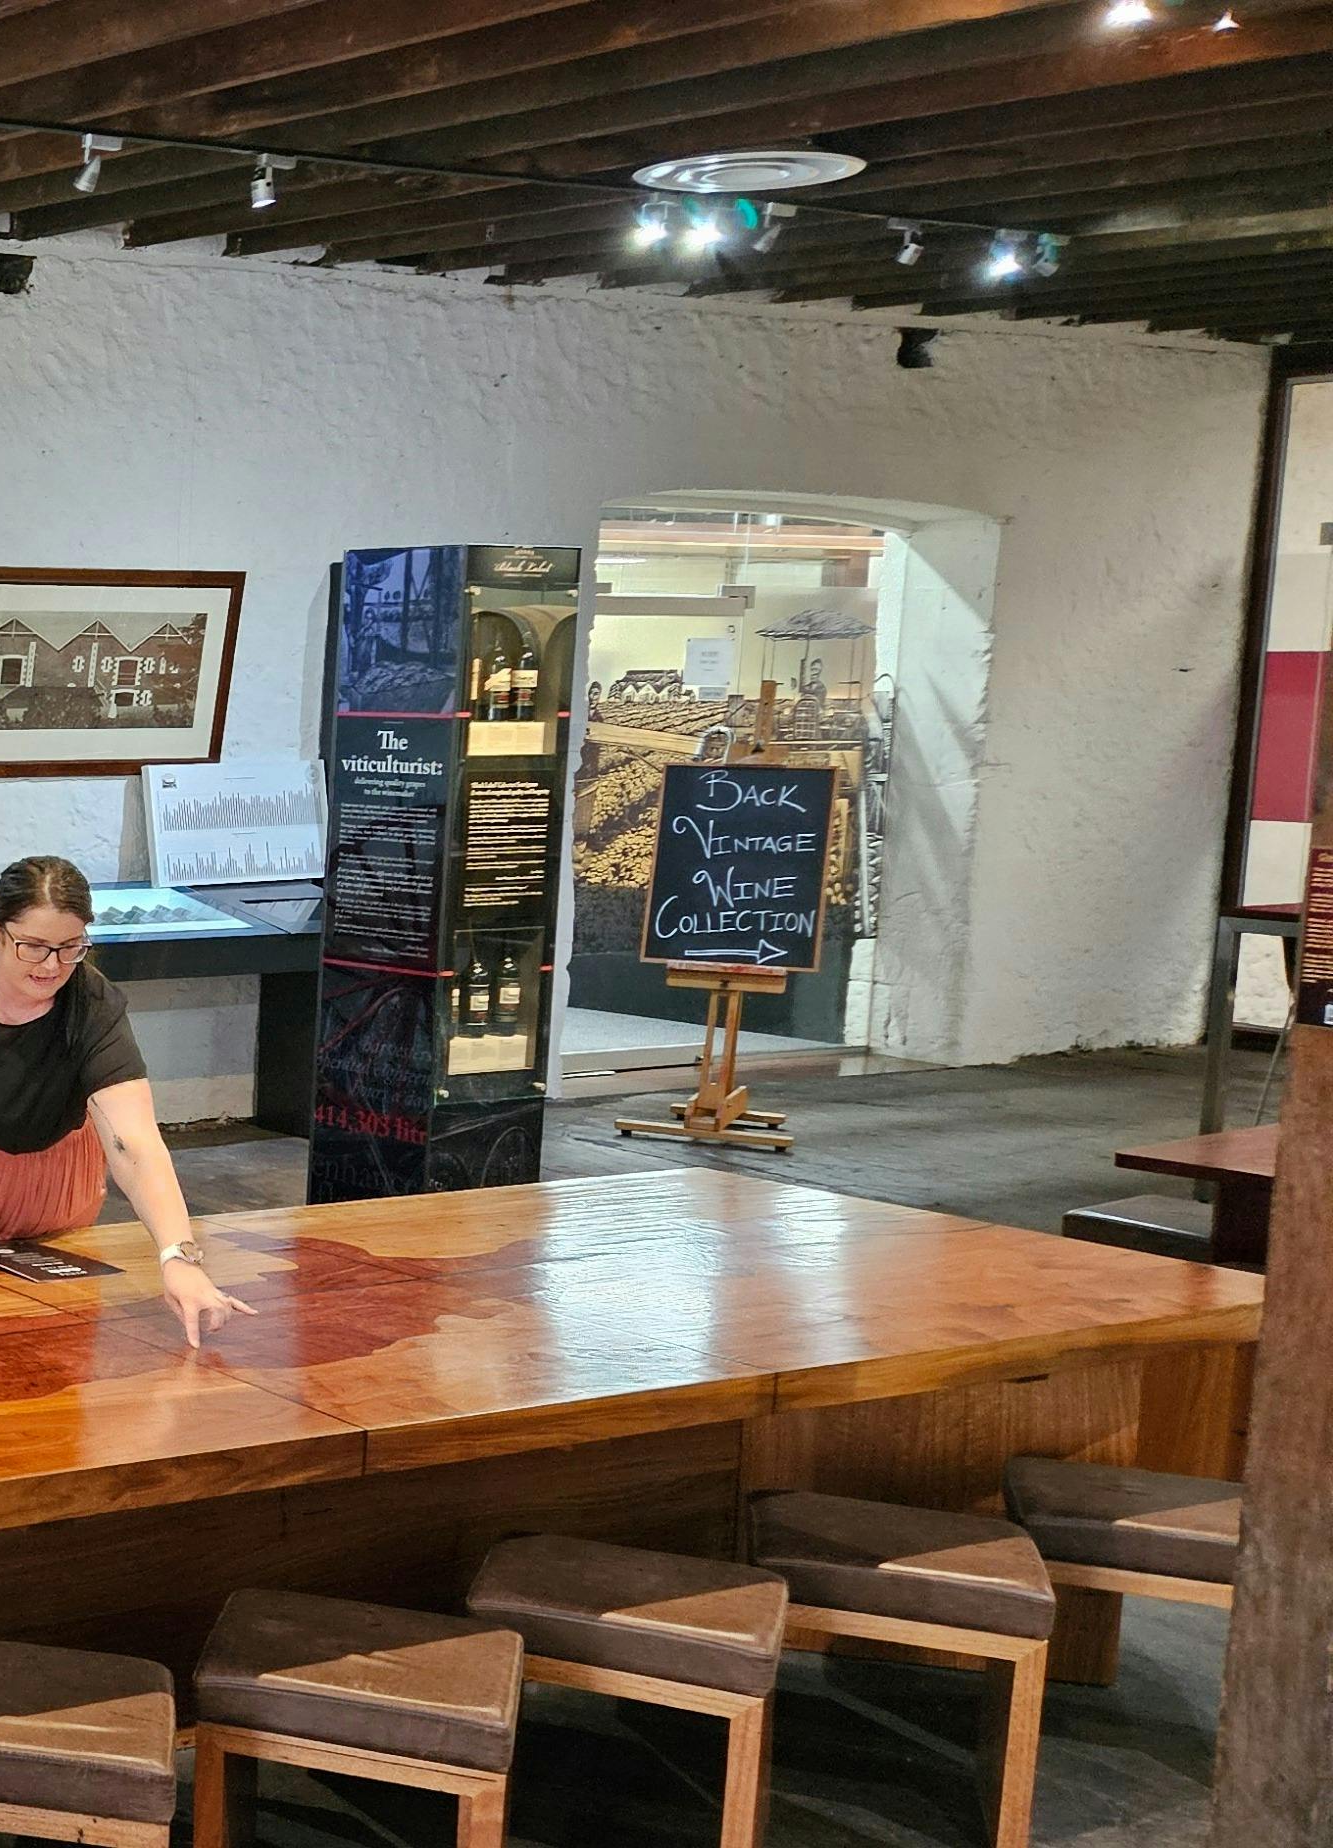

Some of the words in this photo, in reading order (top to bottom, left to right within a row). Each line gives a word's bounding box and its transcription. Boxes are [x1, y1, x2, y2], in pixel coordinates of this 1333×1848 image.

[376, 730, 409, 751] The
[341, 754, 443, 776] viticulturist:
[695, 769, 807, 812] BACK
[672, 815, 817, 860] VINTAGE
[691, 866, 799, 907] WINE
[655, 895, 817, 939] COLLECTION
